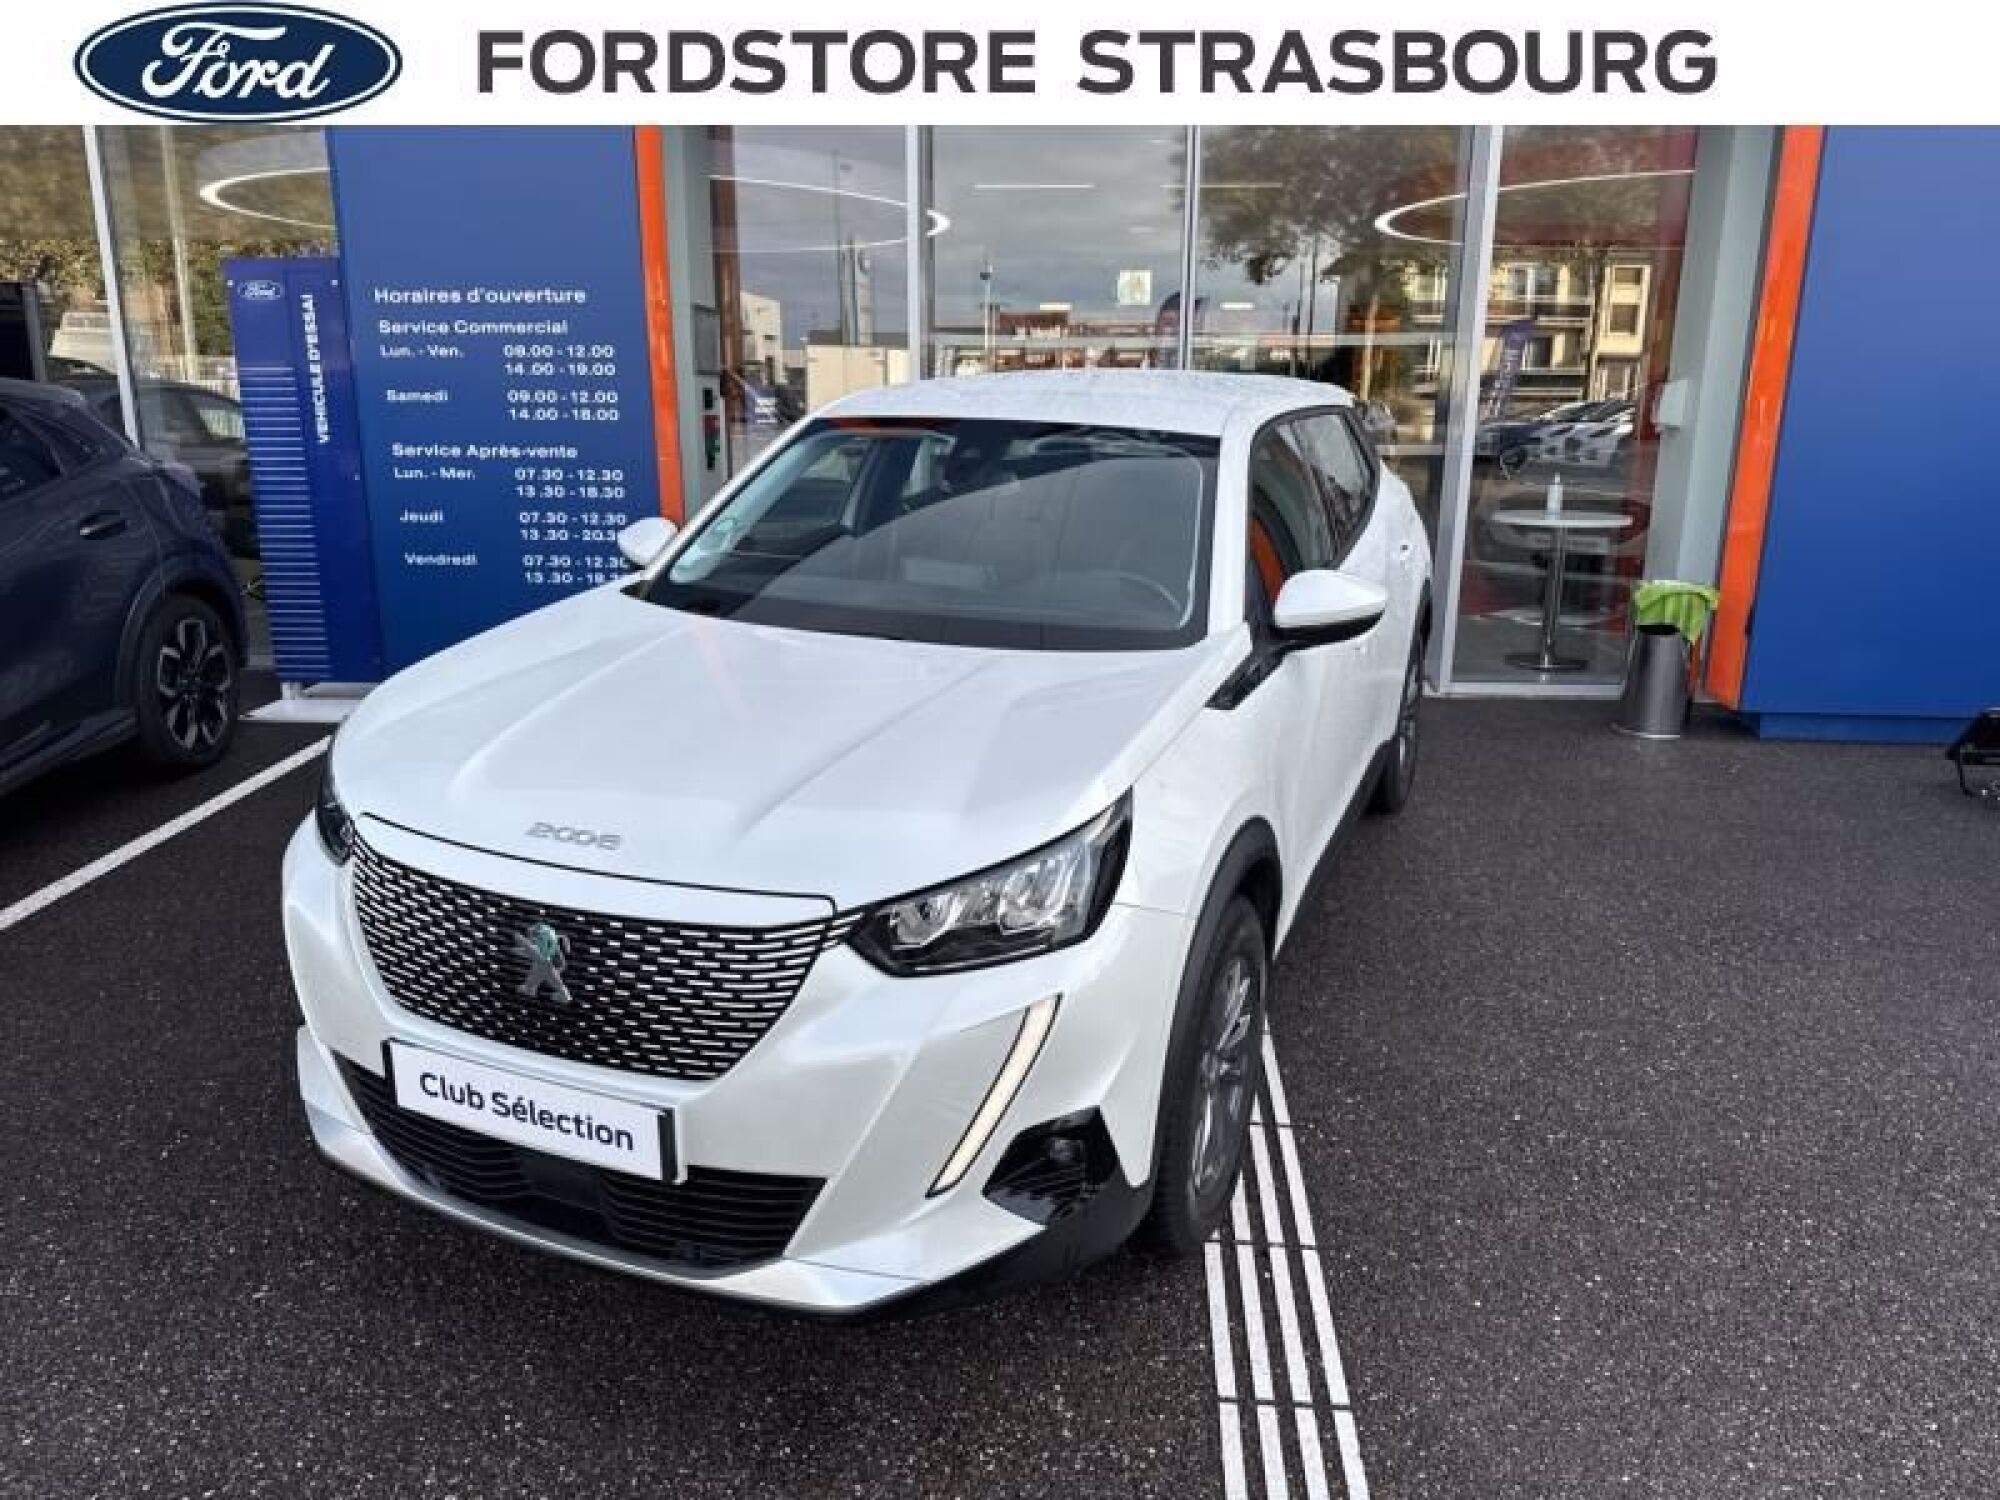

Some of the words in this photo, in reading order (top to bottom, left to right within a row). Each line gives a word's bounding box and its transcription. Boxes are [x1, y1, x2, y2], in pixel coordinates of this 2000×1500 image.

[374, 287, 461, 303] Horaires
[466, 287, 586, 303] d'ouverture
[379, 319, 449, 333] Service
[454, 319, 568, 334] Commercial
[386, 389, 449, 402] Samedi
[392, 443, 461, 457] Service
[467, 444, 579, 460] Après-vente
[400, 510, 444, 523] Jeudi
[582, 529, 616, 541] 20.3
[404, 552, 477, 566] Vendredi
[526, 821, 621, 850] 2008
[419, 1072, 485, 1111] Club
[491, 1091, 634, 1151] Sélection
